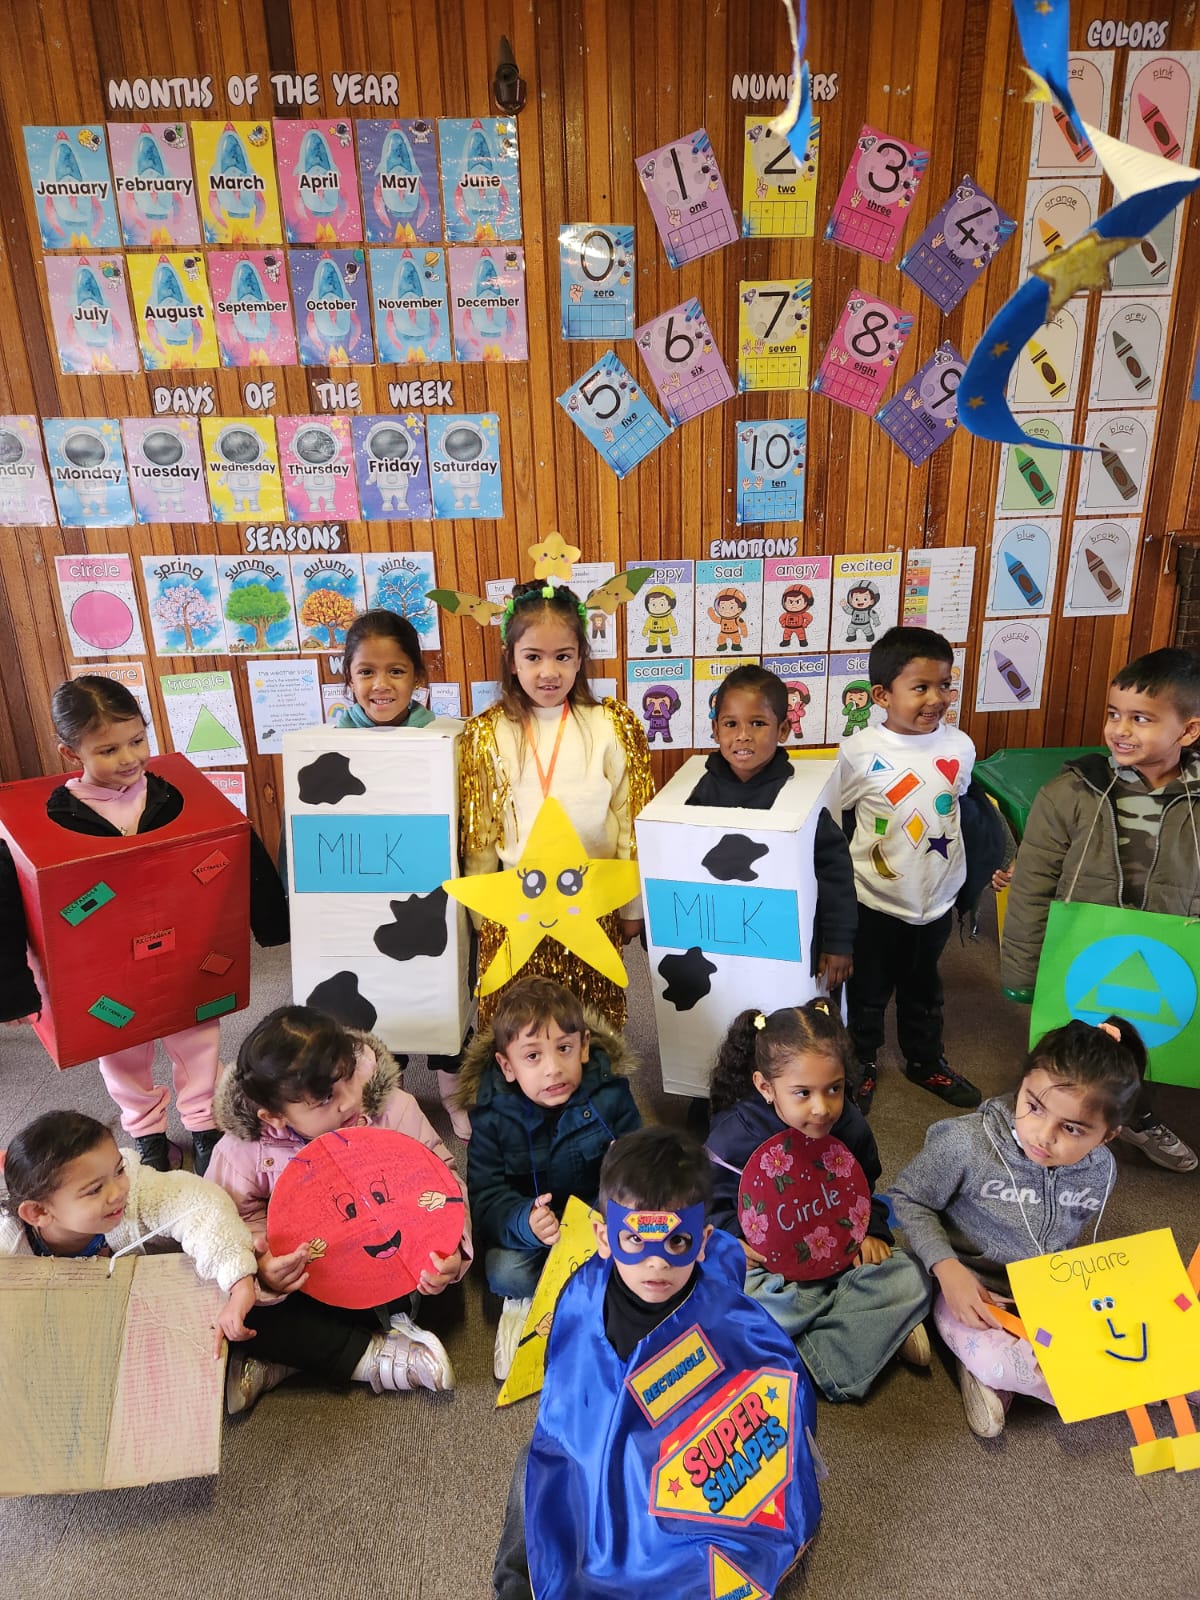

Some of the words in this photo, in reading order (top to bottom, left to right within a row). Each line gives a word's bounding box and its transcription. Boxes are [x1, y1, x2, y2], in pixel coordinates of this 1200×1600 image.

[1087, 20, 1169, 49] COLORS
[1068, 66, 1084, 77] ed
[1153, 67, 1174, 81] pink
[108, 75, 214, 109] MONTHS
[227, 75, 259, 106] OF
[271, 73, 320, 105] THE
[332, 73, 399, 106] YEAR
[731, 73, 839, 101] NUMRS
[671, 148, 688, 200] 1
[868, 143, 907, 193] 3
[36, 181, 108, 198] January
[116, 177, 193, 195] February
[210, 175, 264, 190] March
[300, 173, 338, 190] April
[382, 175, 418, 193] May
[460, 174, 500, 188] June
[777, 184, 796, 194] two
[689, 200, 709, 214] one
[867, 200, 892, 217] three
[1045, 195, 1078, 208] orange
[955, 206, 992, 246] 4
[580, 231, 614, 281] 0
[946, 249, 965, 268] four
[594, 288, 615, 298] zero
[218, 302, 288, 315] September
[307, 299, 356, 311] October
[379, 297, 442, 309] November
[457, 297, 519, 308] December
[74, 307, 109, 324] July
[145, 304, 206, 321] August
[758, 291, 790, 338] 7
[1124, 311, 1147, 322] grey
[665, 316, 694, 362] 6
[852, 311, 889, 357] 8
[768, 344, 797, 354] seven
[690, 366, 706, 378] six
[854, 361, 878, 378] eight
[154, 386, 215, 415] DAYS
[244, 381, 275, 410] OF
[316, 382, 361, 410] THE
[389, 380, 454, 408] WEEK
[579, 370, 621, 419] 5
[931, 368, 963, 410] 9
[621, 412, 638, 430] five
[920, 411, 937, 431] nine
[1109, 424, 1135, 435] black
[751, 434, 791, 471] 10
[0, 464, 35, 482] nday
[56, 467, 122, 483] Monday
[132, 465, 200, 483] Tuesday
[210, 463, 276, 474] Wednesday
[288, 464, 349, 477] Thursday
[369, 459, 421, 475] Friday
[433, 461, 498, 475] Saturday
[771, 479, 787, 488] ten
[245, 525, 341, 552] SEASONS
[1017, 530, 1036, 541] blue
[1090, 533, 1120, 544] brown
[709, 537, 798, 558] EMOTIONS
[69, 562, 121, 578] circle
[154, 558, 204, 582] spring
[225, 559, 282, 580] summer
[303, 557, 354, 579] autumn
[378, 557, 422, 575] winter
[715, 565, 743, 579] Sad
[776, 563, 819, 578] angry
[841, 559, 893, 573] excited
[1001, 632, 1029, 643] purple
[635, 664, 683, 677] scared
[711, 662, 742, 675] tire
[847, 656, 869, 670] Sic
[167, 674, 225, 690] triangle
[318, 832, 404, 875] MILK
[673, 891, 767, 946] MILK
[777, 1183, 841, 1231] Circle
[637, 1215, 669, 1225] SUPER
[637, 1224, 670, 1233] SHAPES
[1050, 1251, 1130, 1291] Square
[642, 1346, 707, 1405] RECTANGLE
[682, 1391, 771, 1488] SUPER
[702, 1416, 788, 1513] SHAPES
